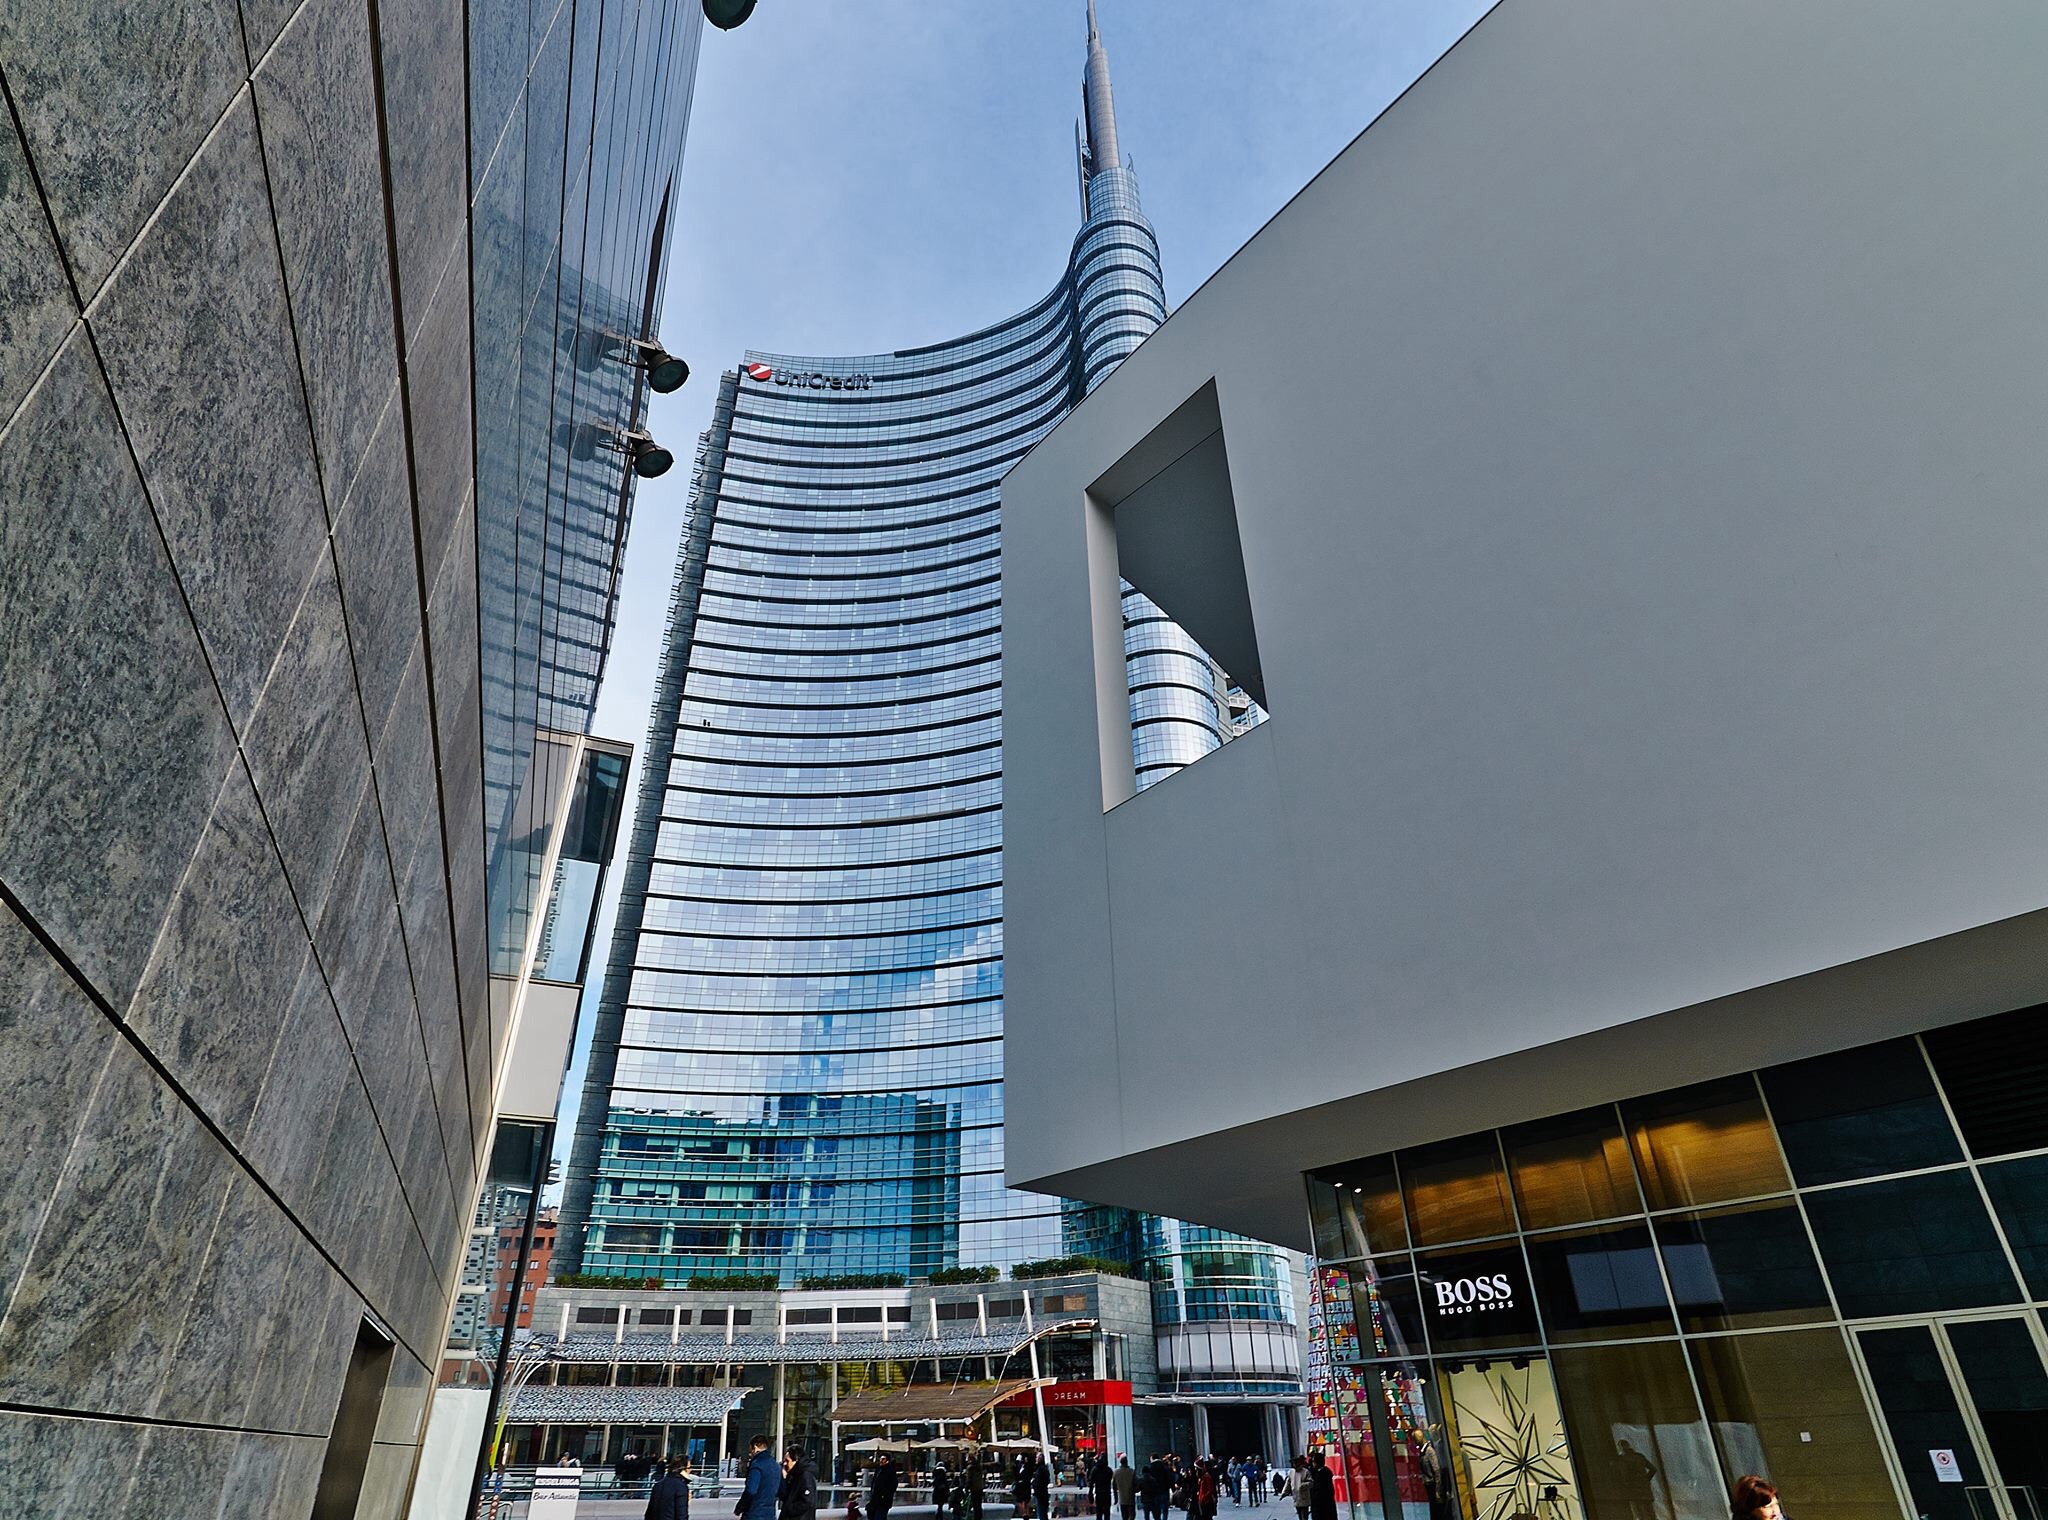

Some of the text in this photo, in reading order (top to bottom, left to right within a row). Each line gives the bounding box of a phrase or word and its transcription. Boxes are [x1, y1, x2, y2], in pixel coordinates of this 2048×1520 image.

[774, 368, 871, 391] UniCredit
[1434, 1273, 1512, 1307] BOSS
[1439, 1300, 1514, 1316] HUGO BOSS
